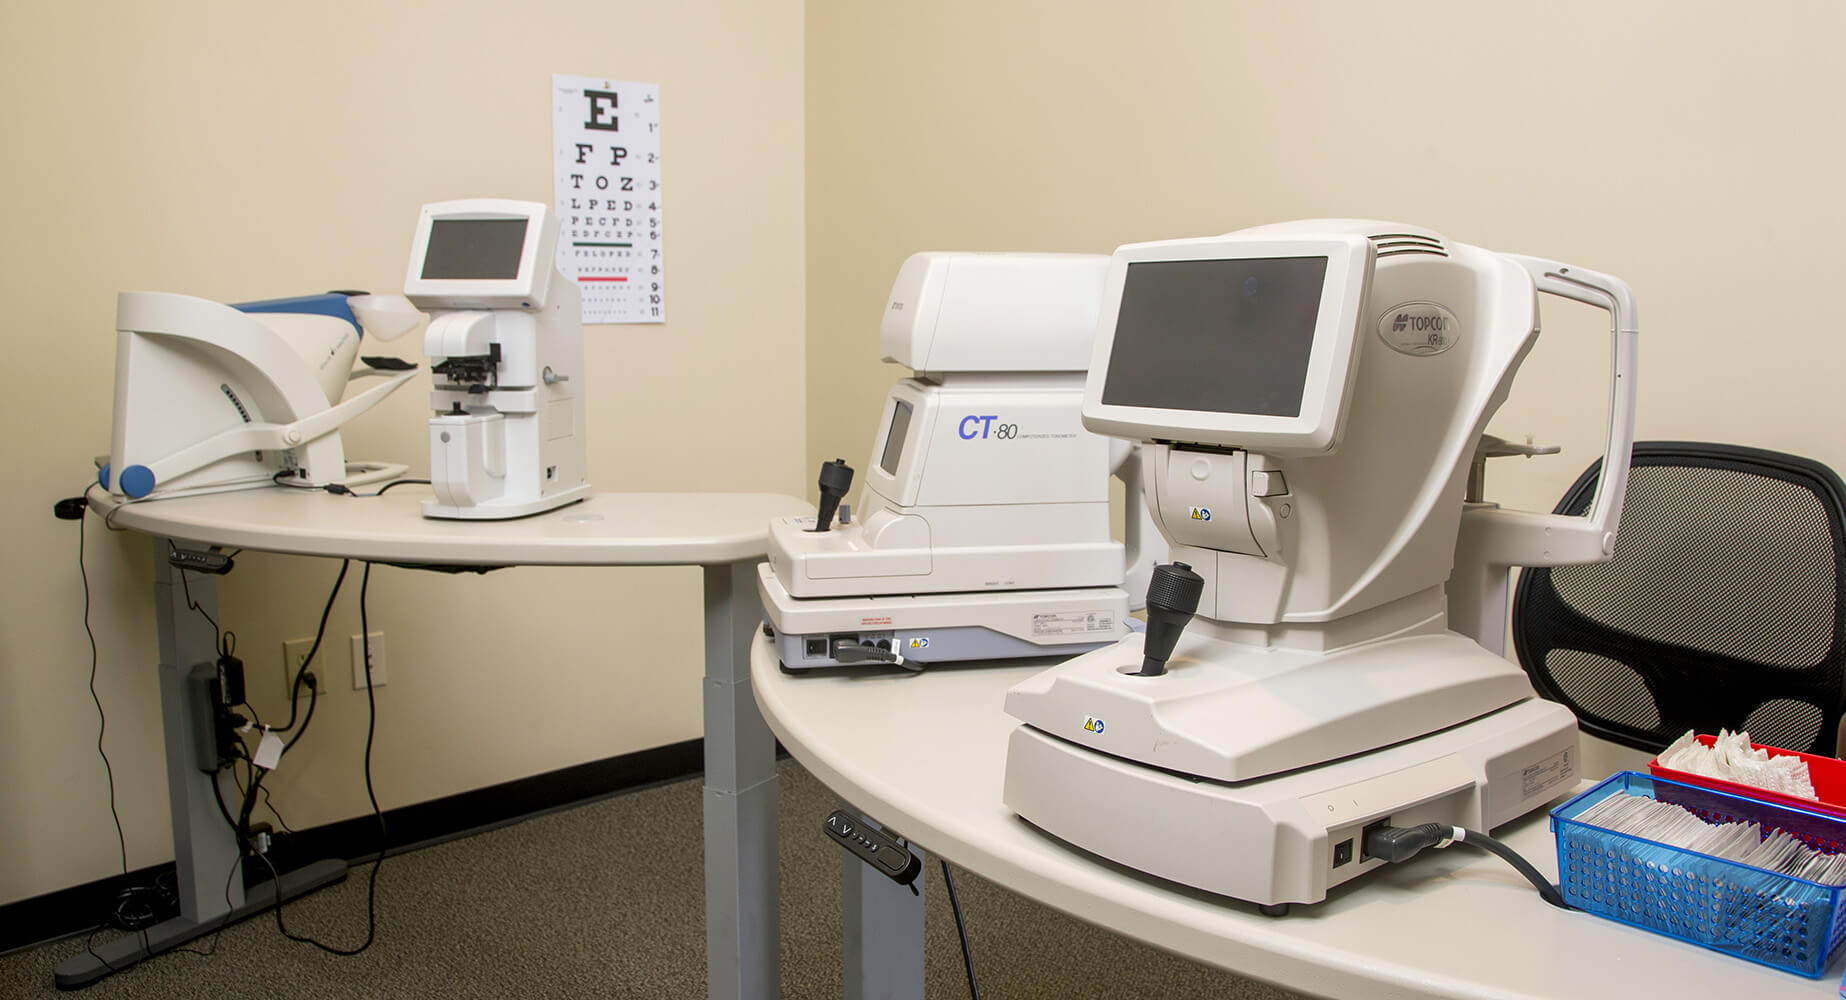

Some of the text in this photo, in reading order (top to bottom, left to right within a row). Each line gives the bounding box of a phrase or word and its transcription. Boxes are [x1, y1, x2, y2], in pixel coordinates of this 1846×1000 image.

[584, 88, 618, 132] E
[648, 122, 654, 133] 1
[575, 143, 628, 166] F P
[647, 152, 655, 164] 2
[649, 180, 657, 191] 3
[648, 202, 657, 212] 4
[649, 217, 657, 228] 5
[649, 231, 657, 240] 6
[651, 248, 659, 260] 7
[651, 265, 659, 275] 8
[651, 282, 659, 292] 9
[649, 294, 661, 304] 10
[651, 306, 659, 317] 11
